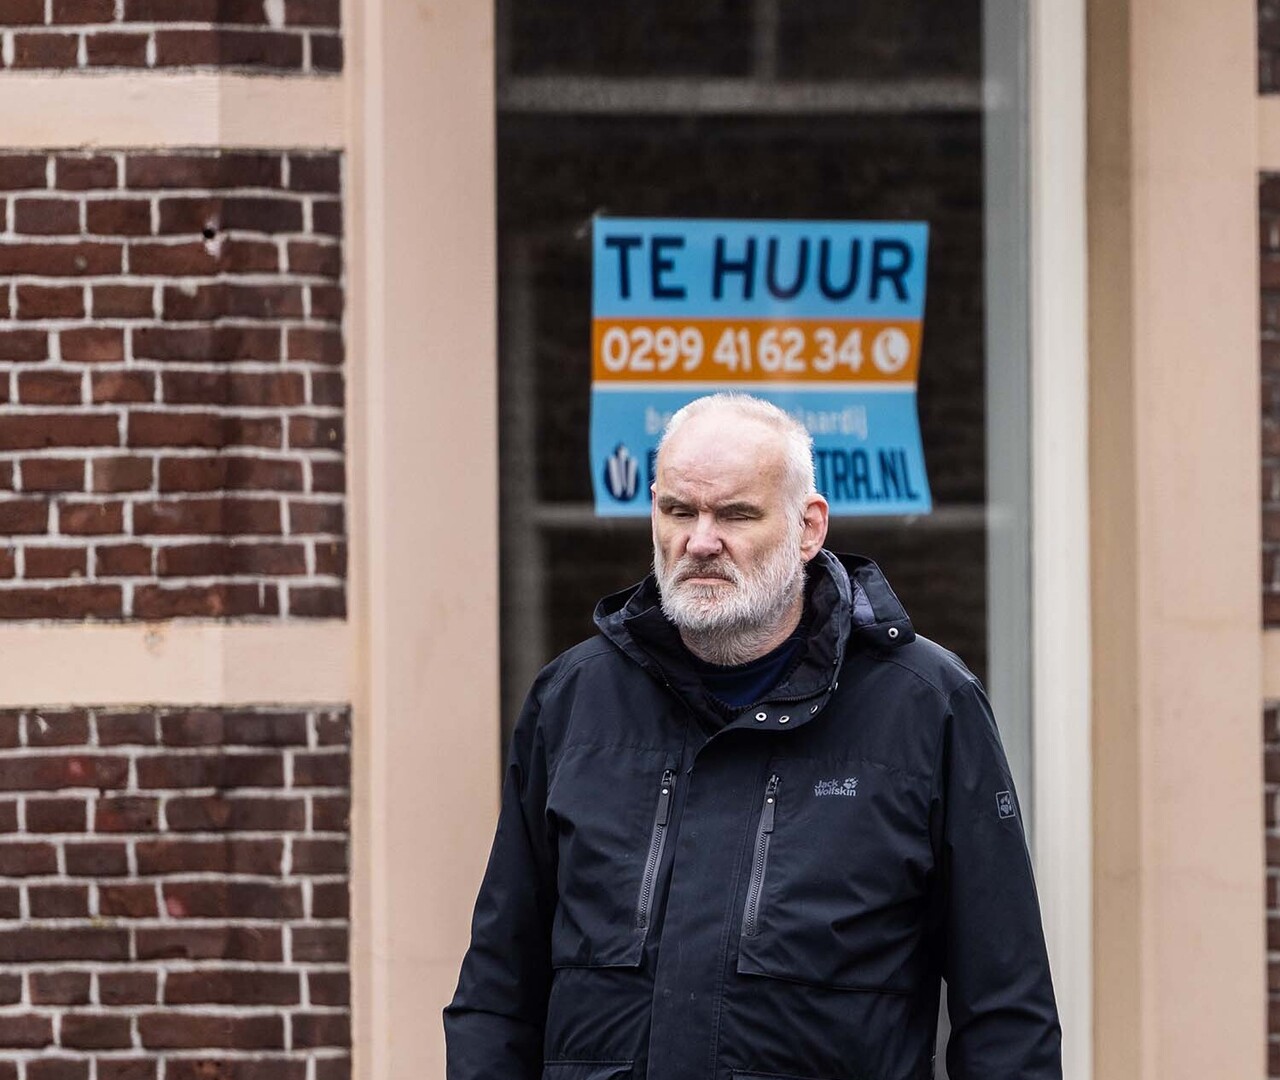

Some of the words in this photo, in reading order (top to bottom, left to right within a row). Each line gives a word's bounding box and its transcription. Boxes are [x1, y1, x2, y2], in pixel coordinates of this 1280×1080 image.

[604, 236, 687, 301] TE
[711, 236, 914, 303] HUUR
[601, 325, 704, 373] 0299
[712, 327, 752, 373] 41
[756, 327, 806, 373] 62
[812, 327, 863, 373] 34
[814, 779, 839, 789] Jack
[814, 785, 857, 797] Wolfskin
